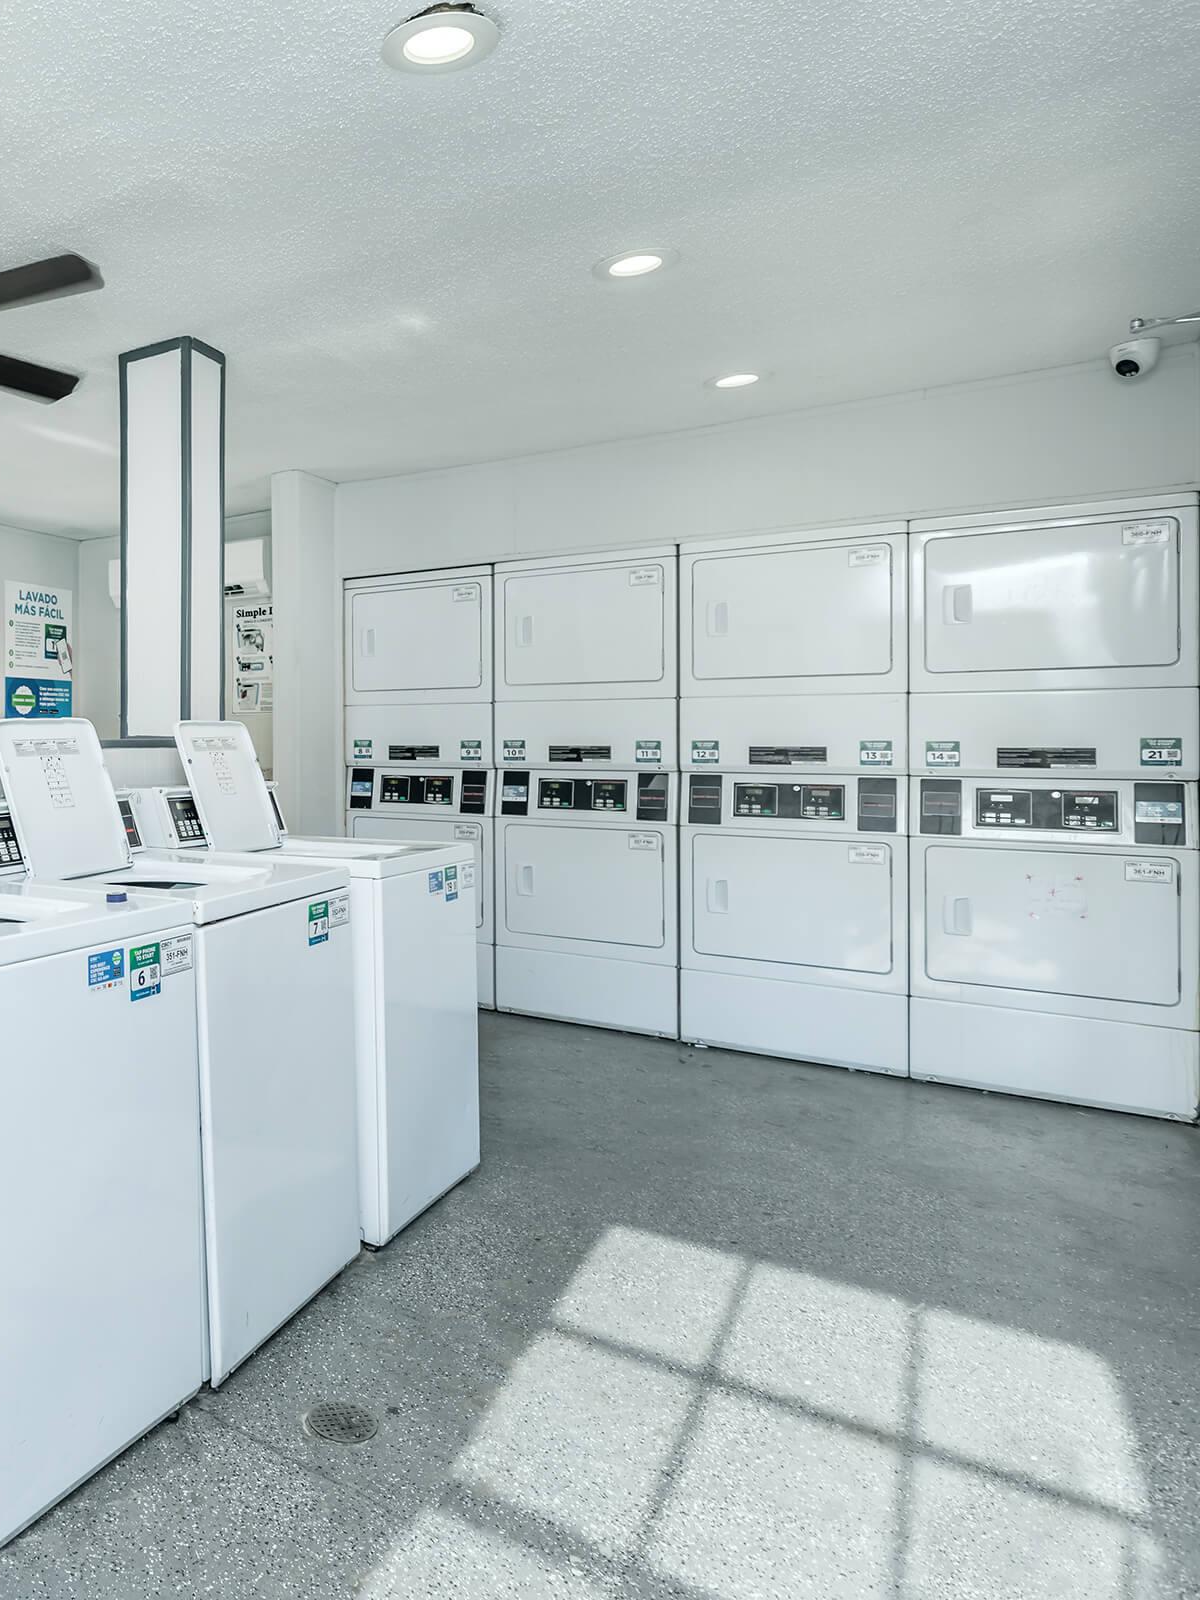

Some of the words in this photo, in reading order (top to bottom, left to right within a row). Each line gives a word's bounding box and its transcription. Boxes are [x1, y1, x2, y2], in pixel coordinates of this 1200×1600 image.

[19, 589, 58, 605] LAVADO
[14, 602, 36, 616] MÁS
[39, 604, 64, 620] FÁCIL
[236, 607, 267, 619] Simple
[865, 751, 877, 759] 13
[1148, 750, 1163, 759] 21
[313, 922, 318, 935] 7
[142, 946, 156, 955] PHONE
[142, 952, 154, 960] START
[138, 970, 145, 986] 6
